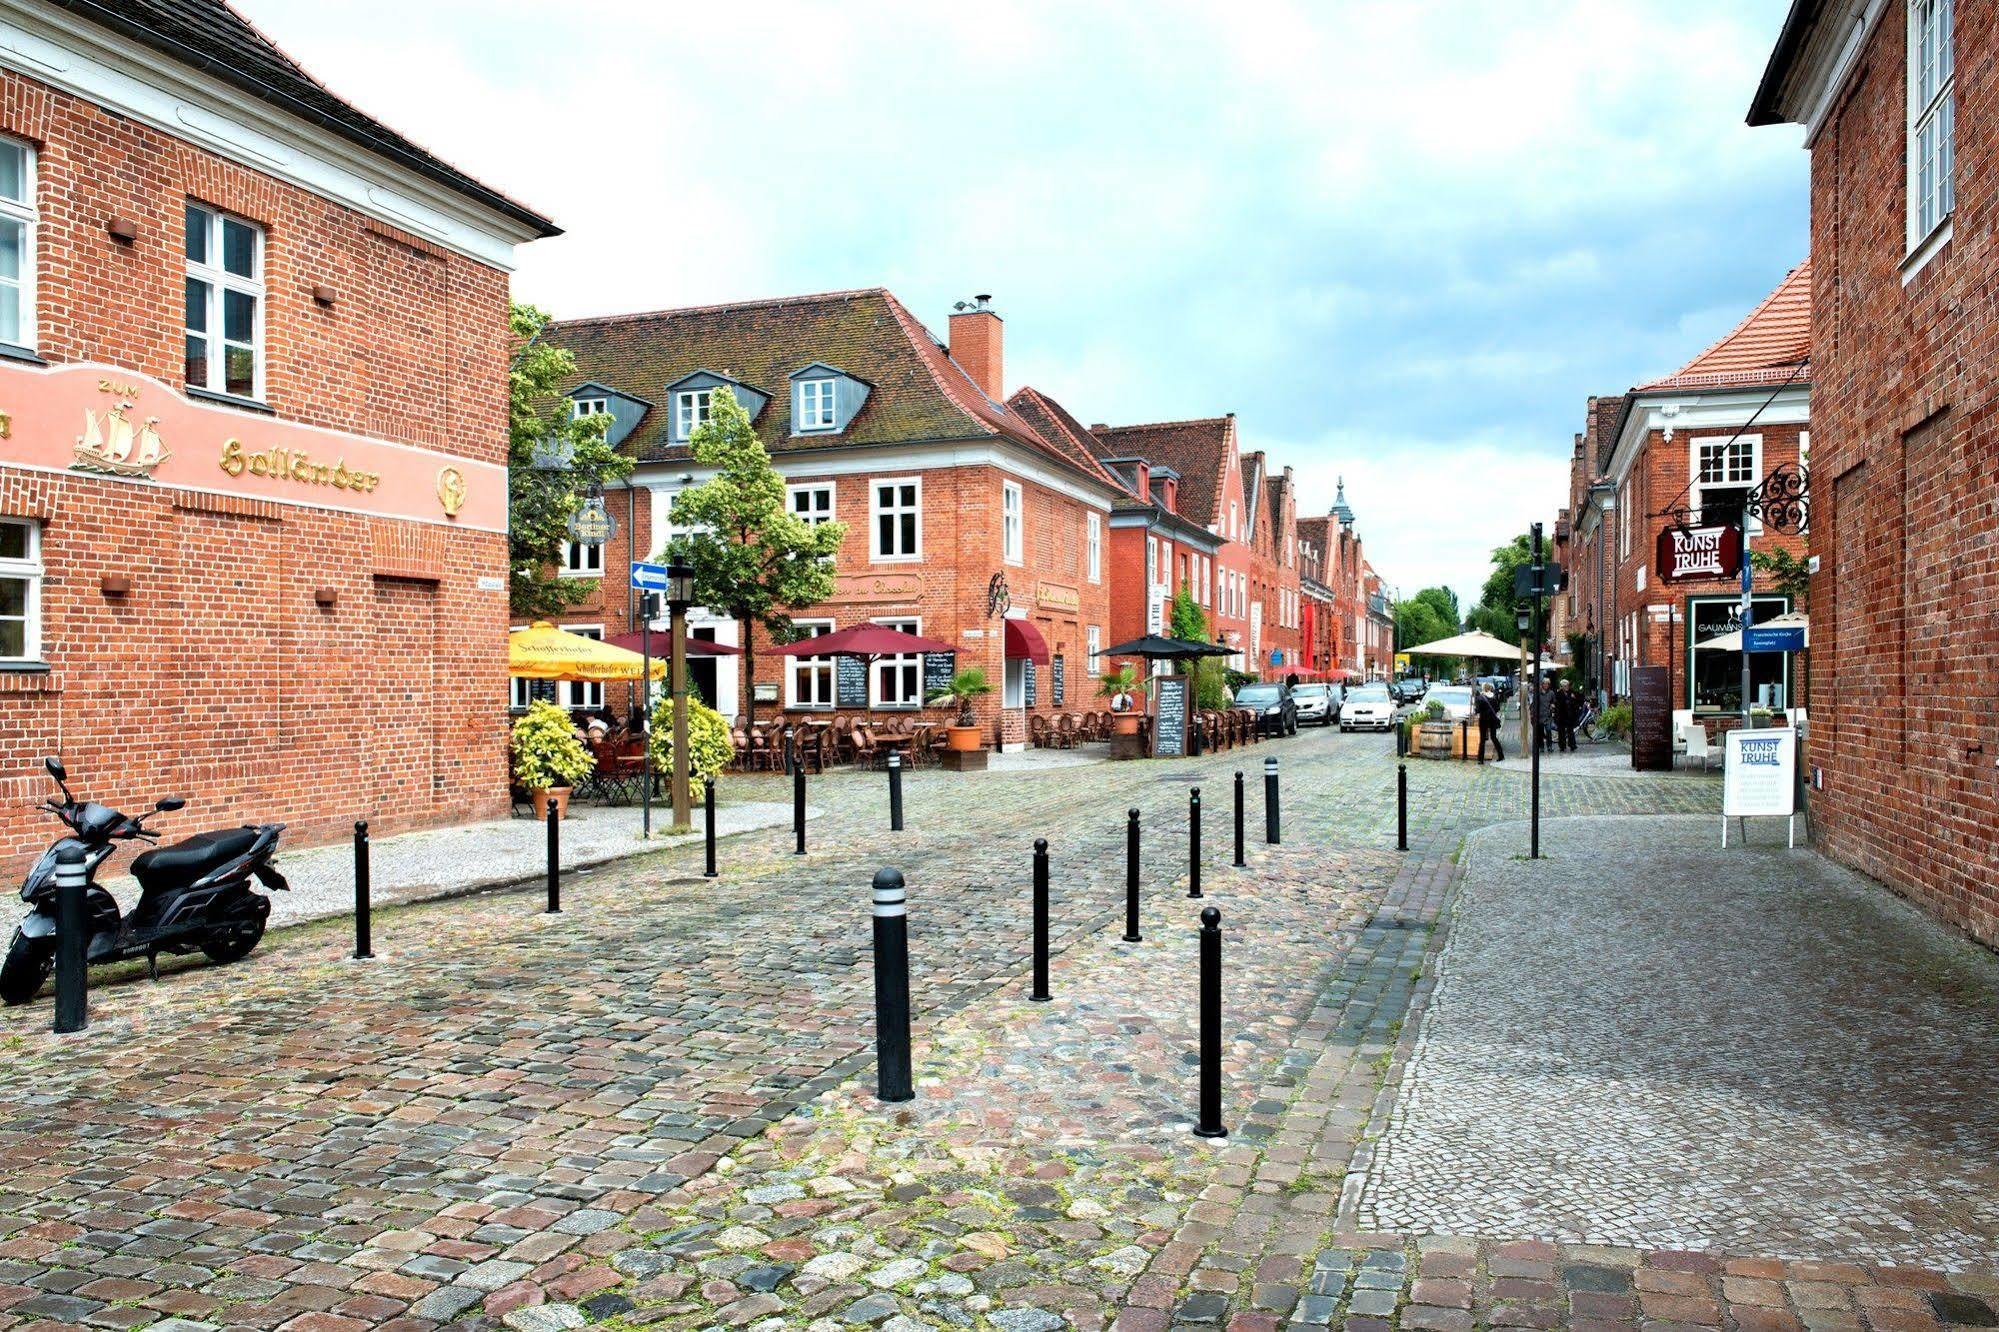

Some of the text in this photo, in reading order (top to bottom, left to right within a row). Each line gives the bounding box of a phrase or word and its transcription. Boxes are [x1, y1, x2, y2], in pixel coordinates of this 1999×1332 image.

[98, 379, 140, 400] ZUM
[219, 437, 381, 493] Holländer
[1674, 534, 1721, 553] KUNST
[1674, 551, 1720, 570] TRUHE
[1698, 623, 1743, 633] GAUMENS
[1741, 742, 1778, 752] KUNST
[1741, 752, 1777, 763] TRUHE
